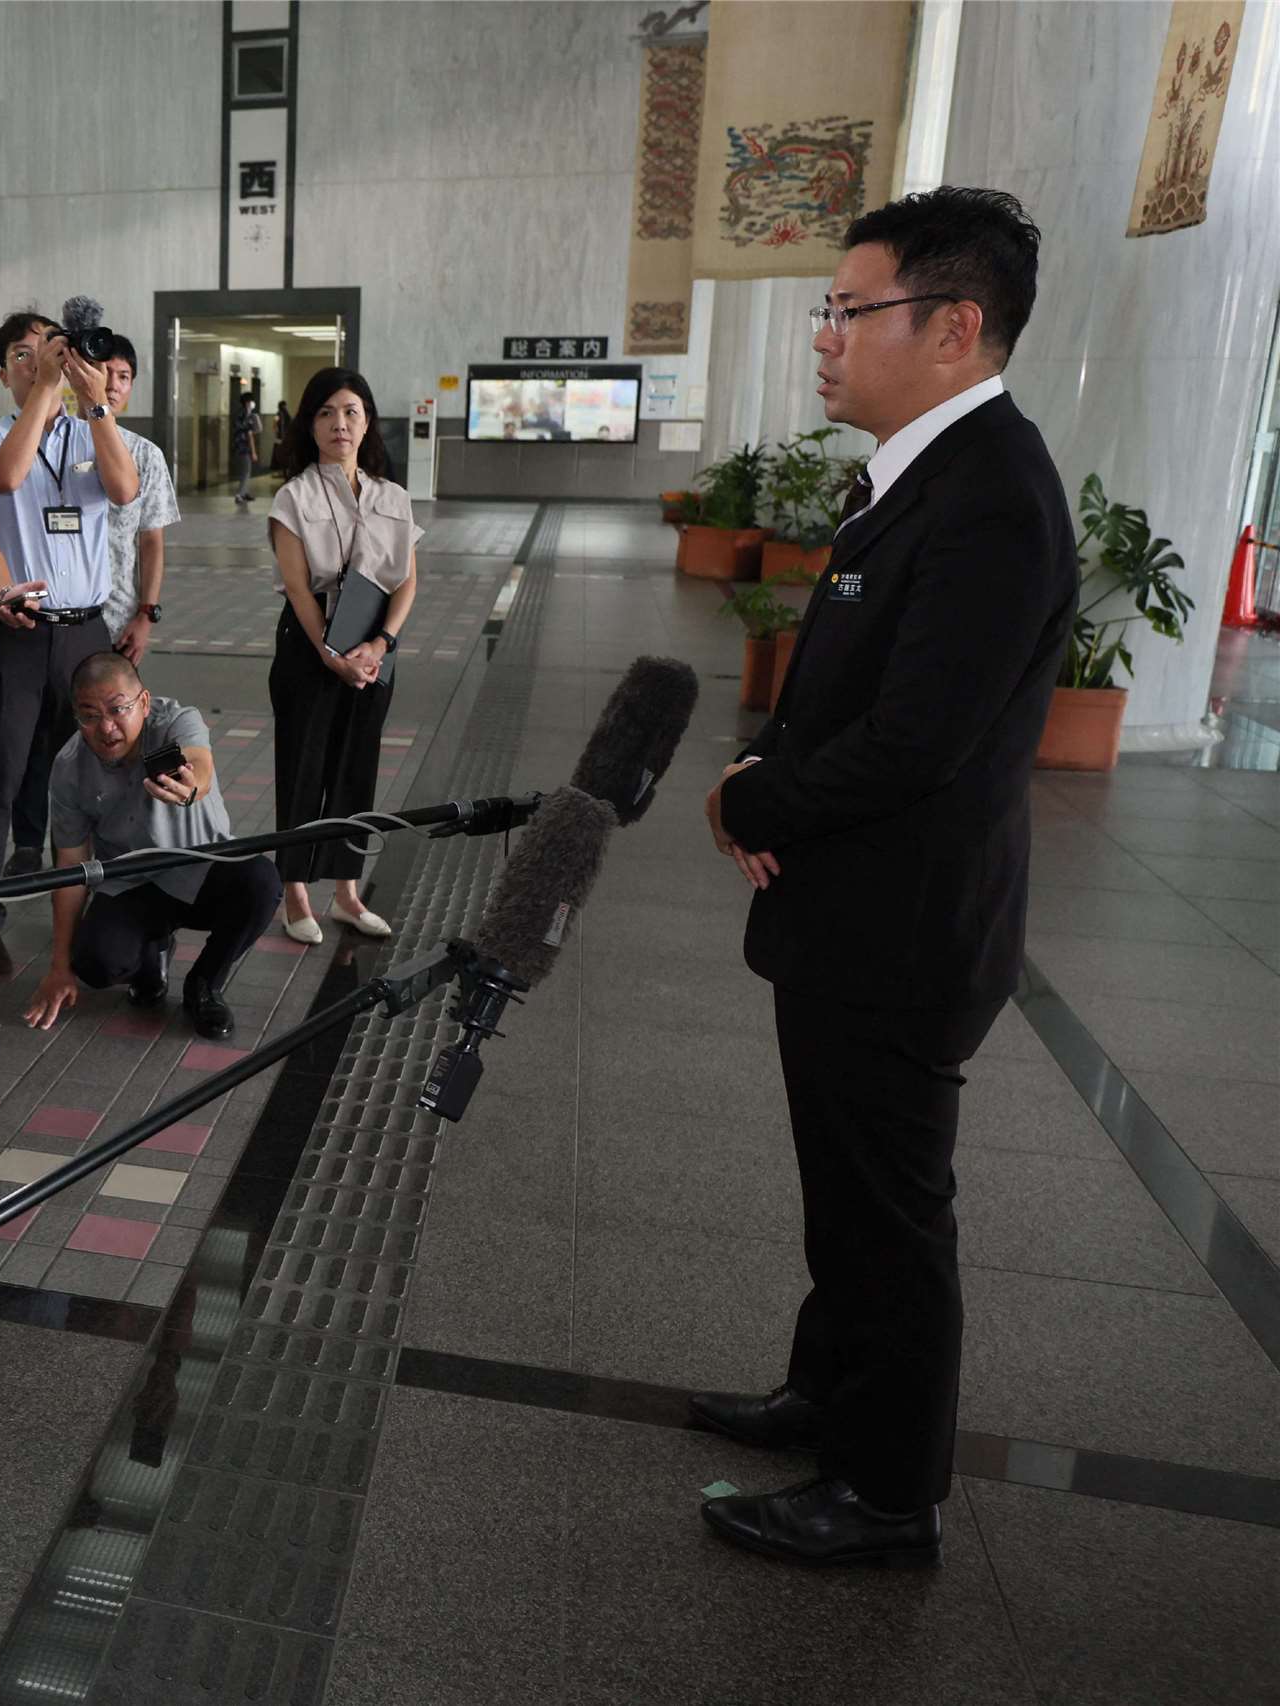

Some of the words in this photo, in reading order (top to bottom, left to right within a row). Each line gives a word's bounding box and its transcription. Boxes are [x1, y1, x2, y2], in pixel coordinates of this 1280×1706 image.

[239, 161, 276, 199] 西
[239, 205, 276, 215] WEST
[510, 340, 601, 357] 総合案内
[520, 367, 588, 379] INFORMATION
